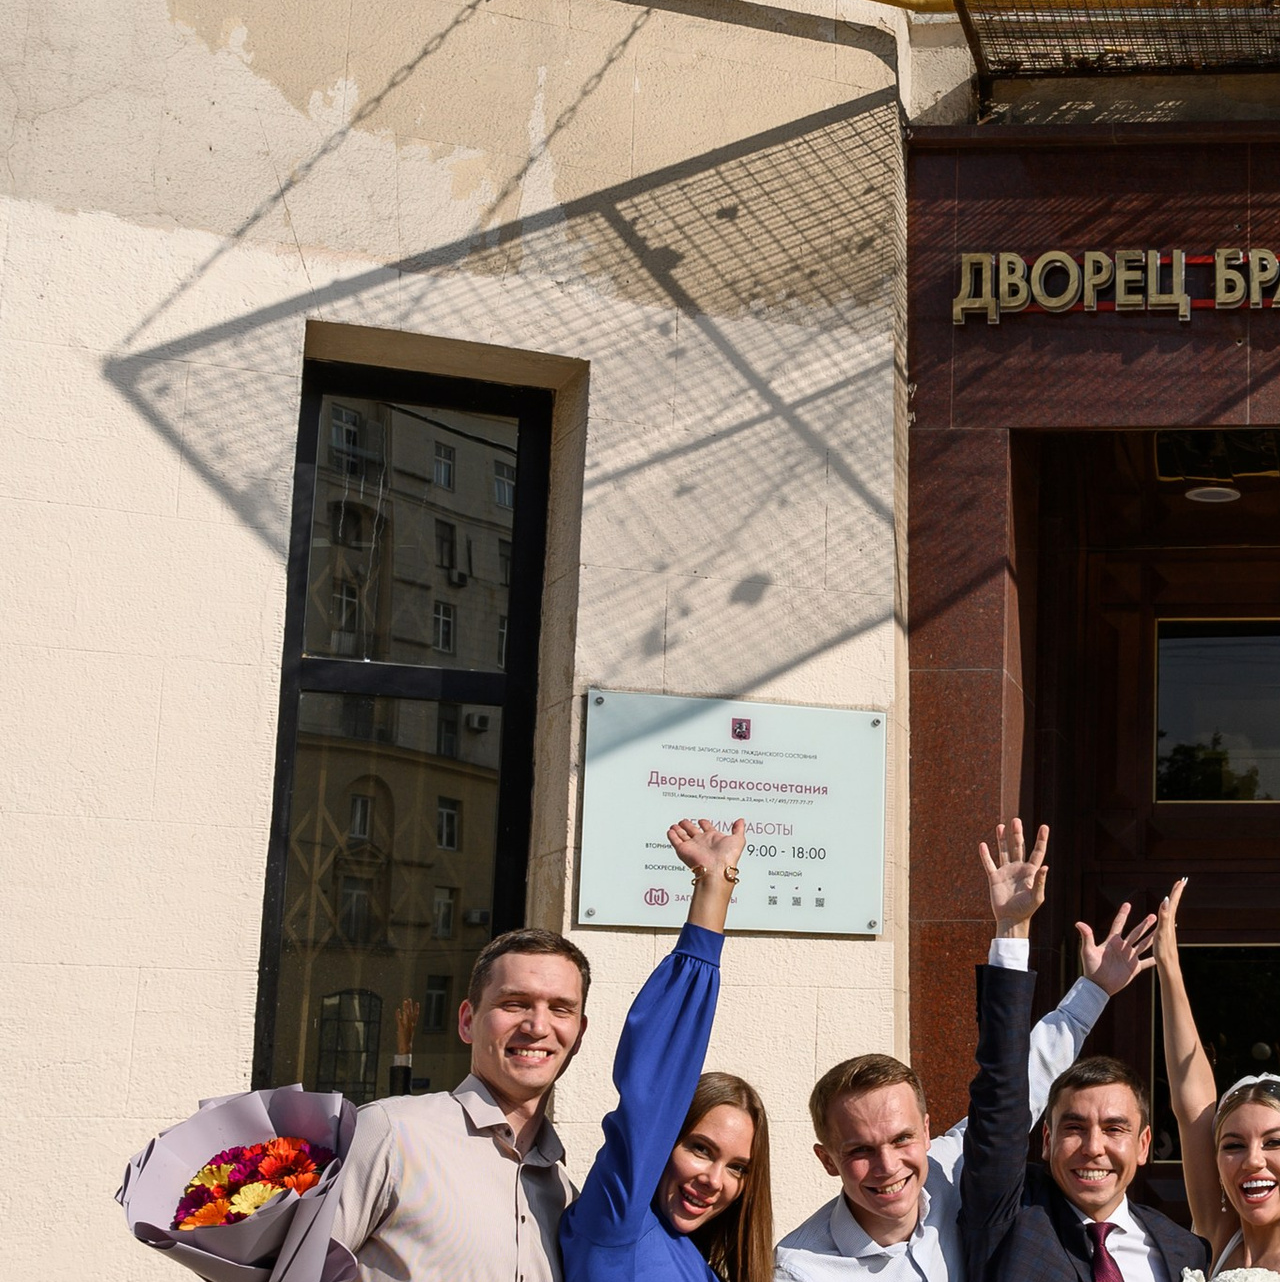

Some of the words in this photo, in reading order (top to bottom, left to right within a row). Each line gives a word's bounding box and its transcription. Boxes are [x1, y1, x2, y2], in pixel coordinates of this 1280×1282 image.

[953, 249, 1191, 324] ДВОРЕЦ
[661, 744, 696, 752] УПРАВЛЕНИЕ
[648, 771, 705, 790] Дворец
[709, 774, 828, 796] бракосочетания
[743, 821, 793, 836] АБОТЫ
[747, 844, 777, 858] 9:00
[791, 846, 827, 860] 18:00
[768, 869, 802, 877] ВЫХОДНОЙ
